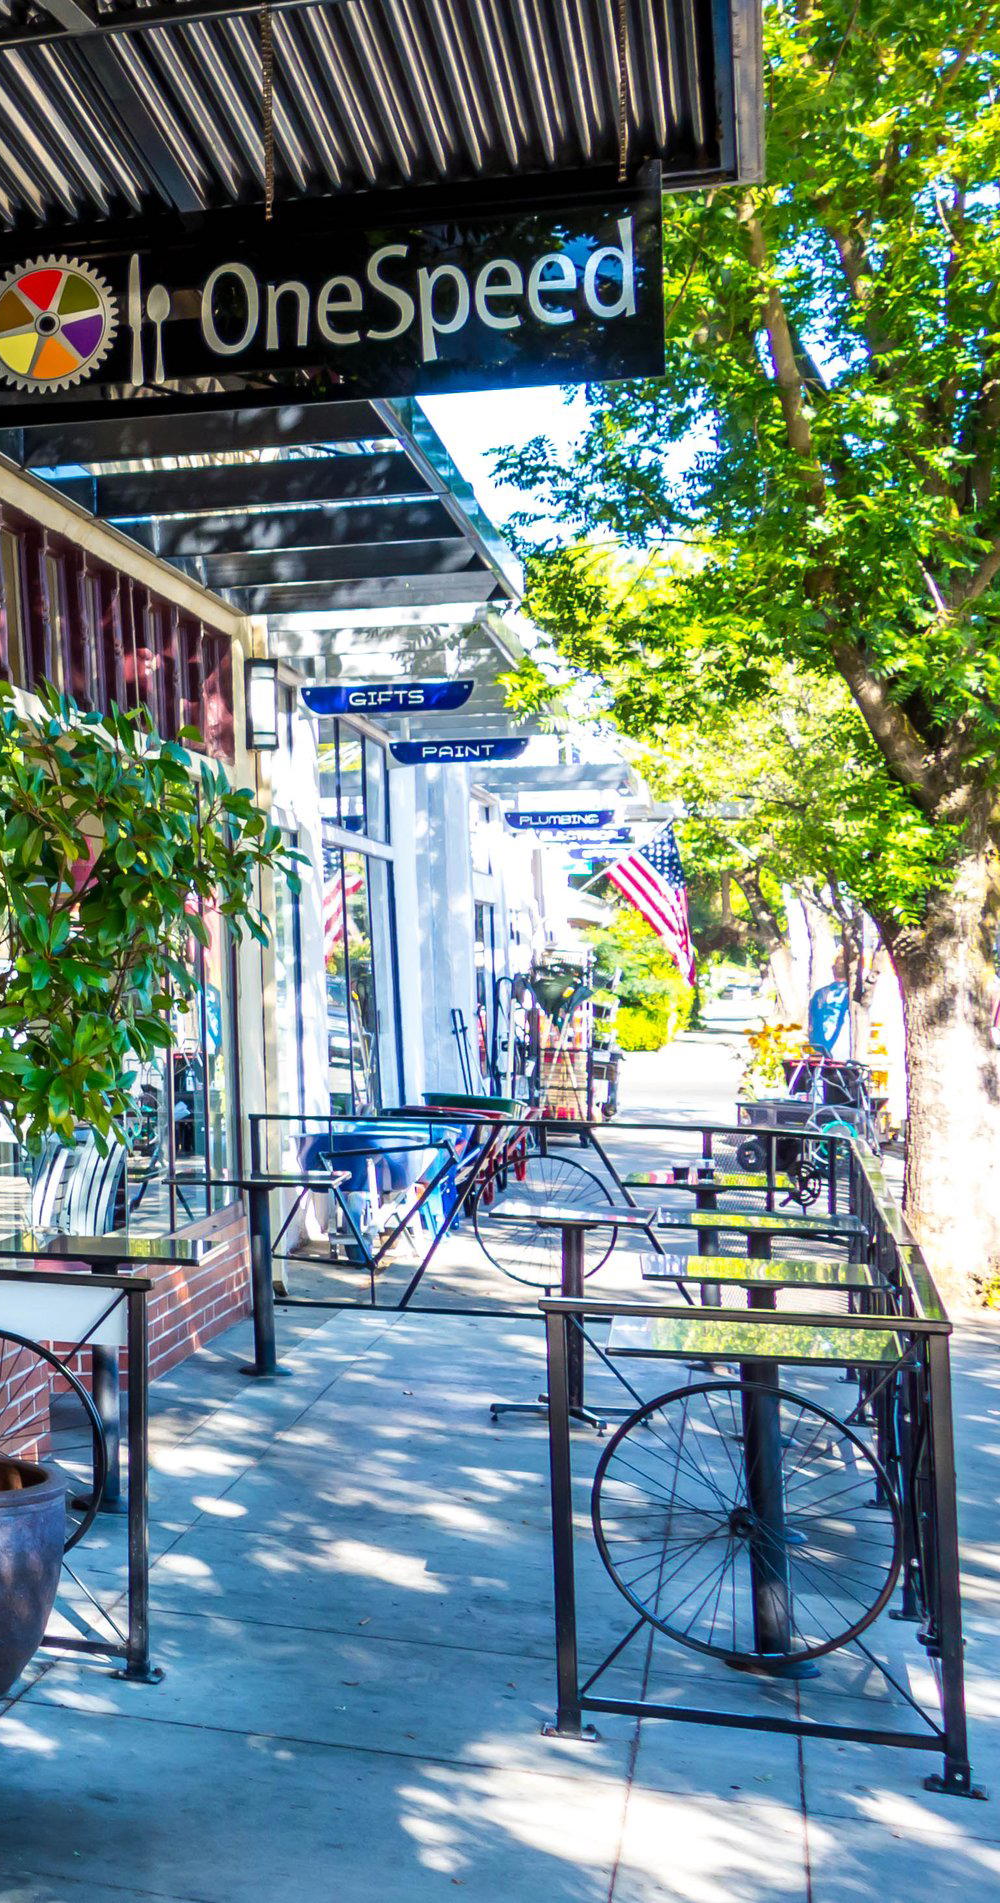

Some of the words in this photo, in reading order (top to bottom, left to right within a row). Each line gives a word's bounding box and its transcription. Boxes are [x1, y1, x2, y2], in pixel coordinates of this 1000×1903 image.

[200, 217, 636, 361] OneSpeed
[349, 689, 424, 706] GIFTS
[422, 744, 494, 758] PAINT
[519, 814, 600, 825] PLUMBING
